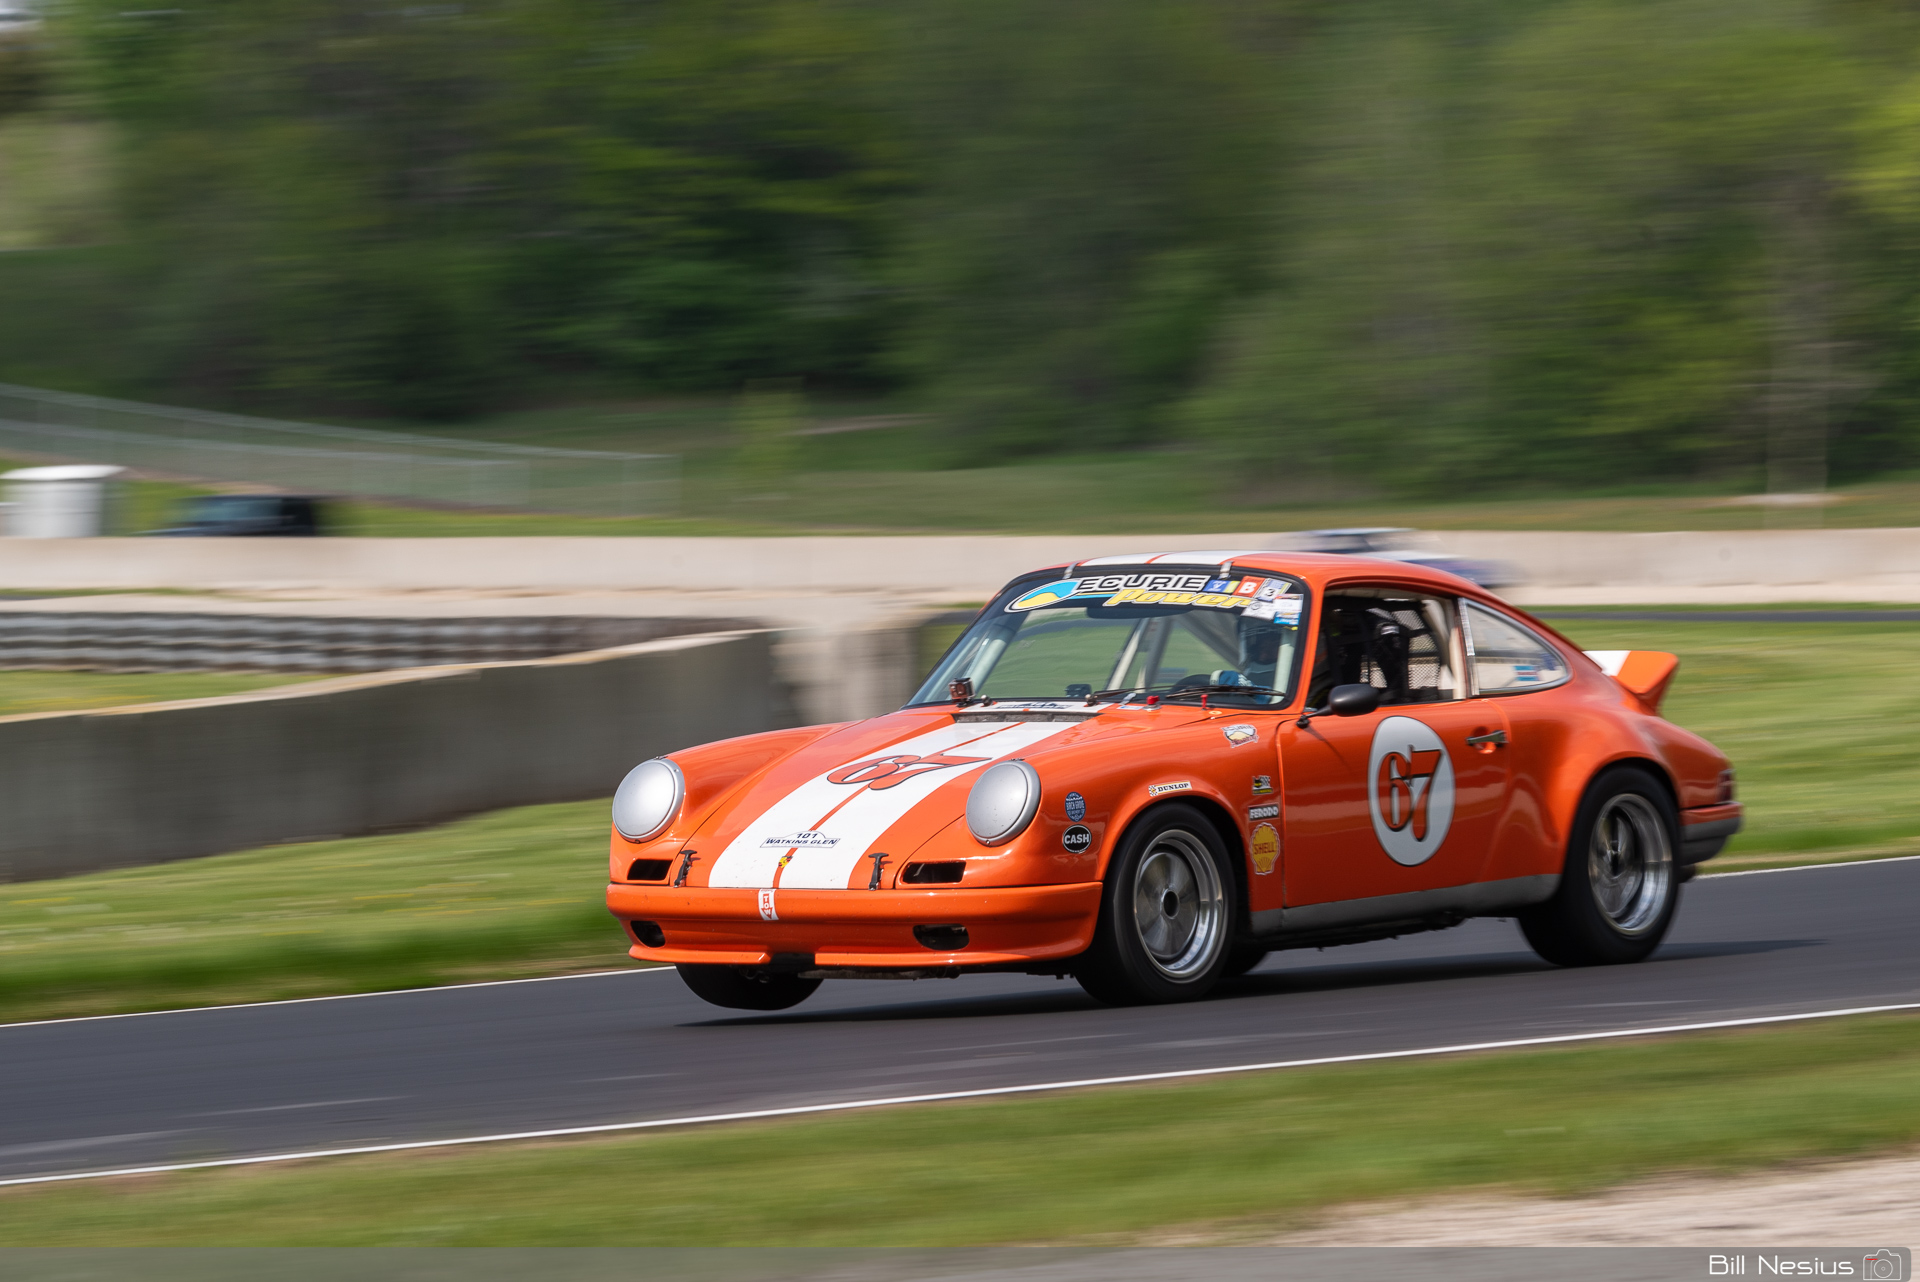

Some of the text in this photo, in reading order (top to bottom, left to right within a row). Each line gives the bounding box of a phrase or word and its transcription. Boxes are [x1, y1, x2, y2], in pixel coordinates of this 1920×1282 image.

[1077, 574, 1211, 592] ECURIE
[1238, 581, 1257, 594] B
[827, 754, 993, 791] 67
[1157, 783, 1189, 792] DUNLOP
[1377, 744, 1443, 842] 67
[1249, 806, 1279, 819] FERODO
[1064, 833, 1090, 845] CASH
[1253, 842, 1276, 855] SHELL
[763, 895, 772, 916] TOW
